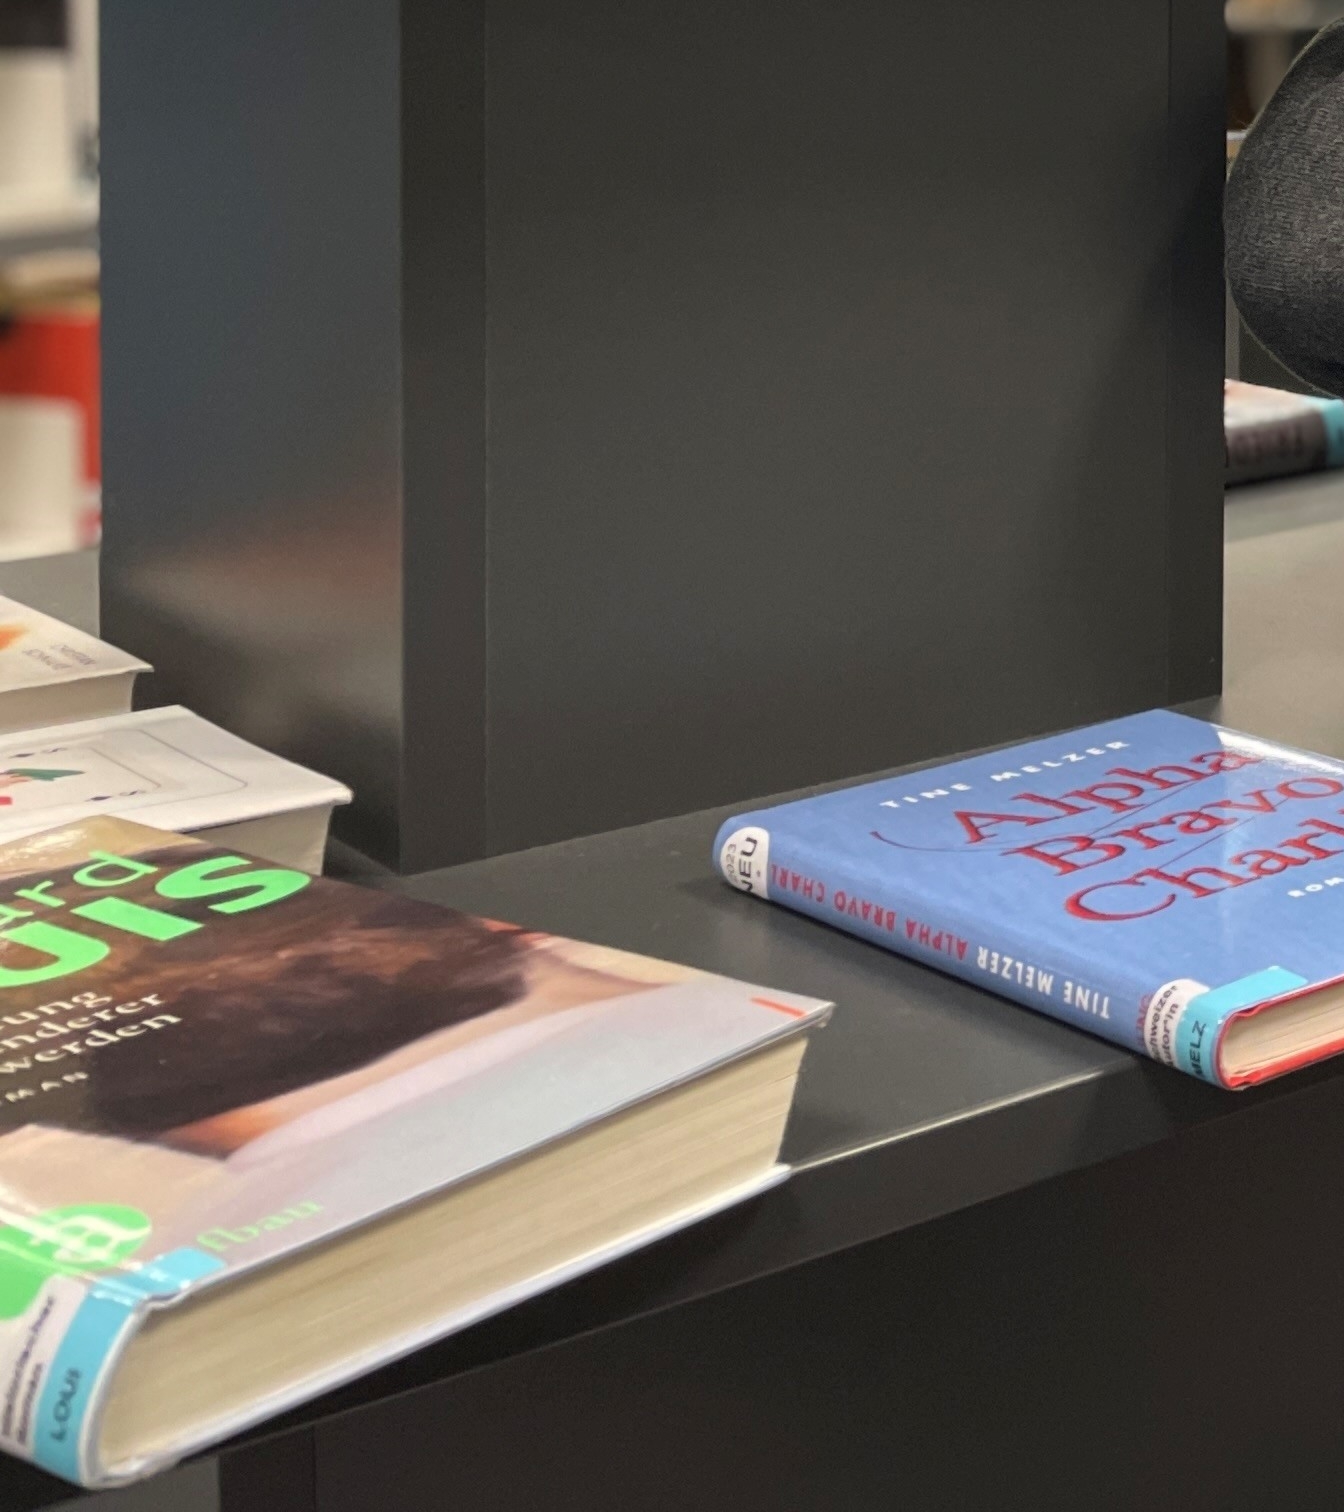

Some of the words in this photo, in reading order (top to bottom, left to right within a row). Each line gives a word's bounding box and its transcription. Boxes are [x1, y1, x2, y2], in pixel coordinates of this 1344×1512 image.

[880, 783, 973, 809] TINE
[990, 741, 1130, 782] MELZER
[954, 749, 1264, 846] Alpha
[999, 776, 1344, 877] Bravo
[834, 891, 897, 932] BRAVO
[906, 918, 968, 961] ALPHA
[977, 945, 1054, 996] MELZER
[0, 991, 113, 1030] ung
[0, 993, 165, 1053] nderer
[1064, 980, 1110, 1020] TINE
